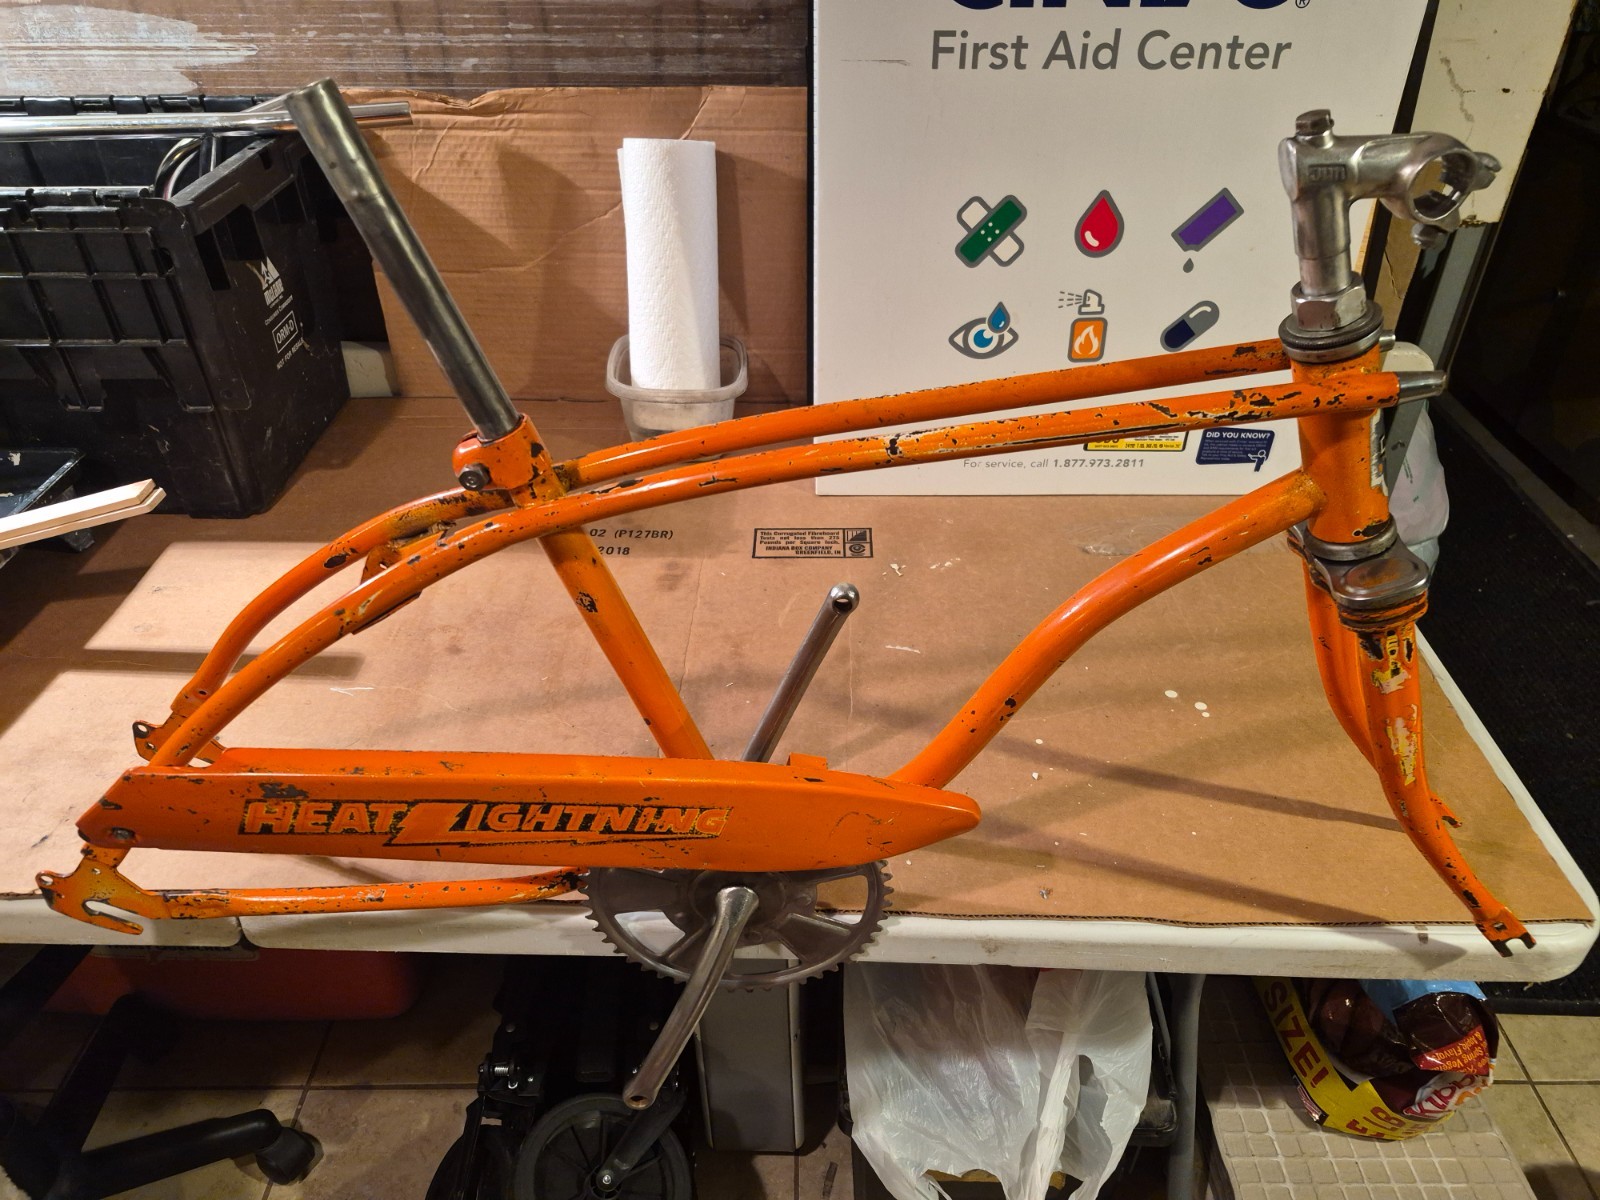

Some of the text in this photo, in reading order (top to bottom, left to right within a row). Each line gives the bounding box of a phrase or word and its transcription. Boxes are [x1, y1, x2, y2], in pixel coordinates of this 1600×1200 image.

[931, 28, 1292, 70] First Aid Center
[276, 319, 295, 344] ORM-D
[963, 458, 1144, 469] For service, call 1.877.973.2811
[614, 529, 674, 540] (P127BR)
[597, 546, 630, 555] 2018
[238, 798, 409, 835] HEAT
[1264, 981, 1330, 1089] SIZE!
